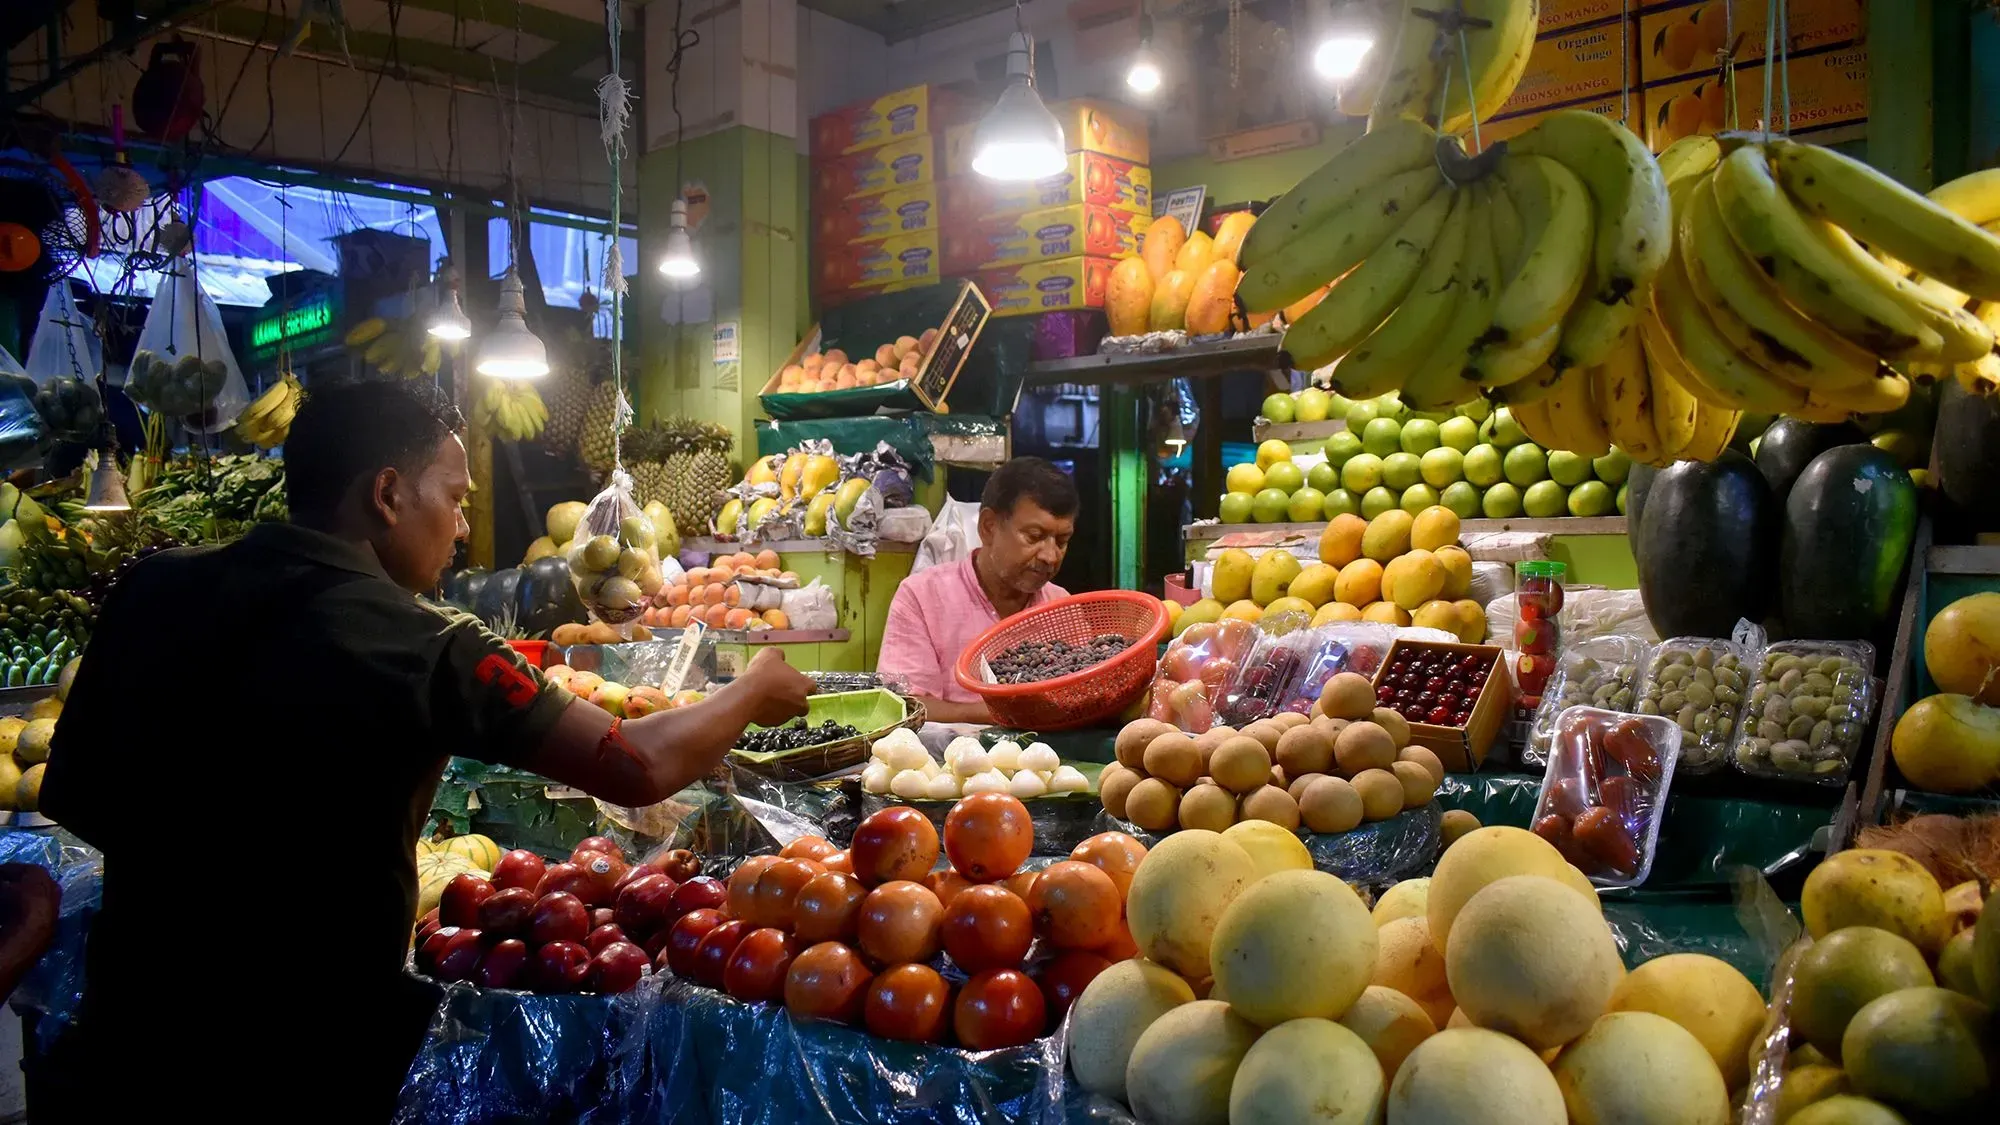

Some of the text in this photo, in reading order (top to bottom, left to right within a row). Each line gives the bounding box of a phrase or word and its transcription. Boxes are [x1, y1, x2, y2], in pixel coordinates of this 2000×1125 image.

[1564, 3, 1609, 21] MANGO
[1828, 23, 1858, 37] MAN
[1557, 32, 1608, 52] Organic
[1574, 49, 1612, 63] Mango
[1824, 52, 1868, 68] Orga
[1565, 77, 1610, 95] MANGO
[1590, 103, 1614, 114] anic
[1752, 102, 1865, 130] APHONSO MAN
[1041, 239, 1071, 256] GPM
[1041, 291, 1071, 307] GPM
[475, 653, 537, 708] 3
